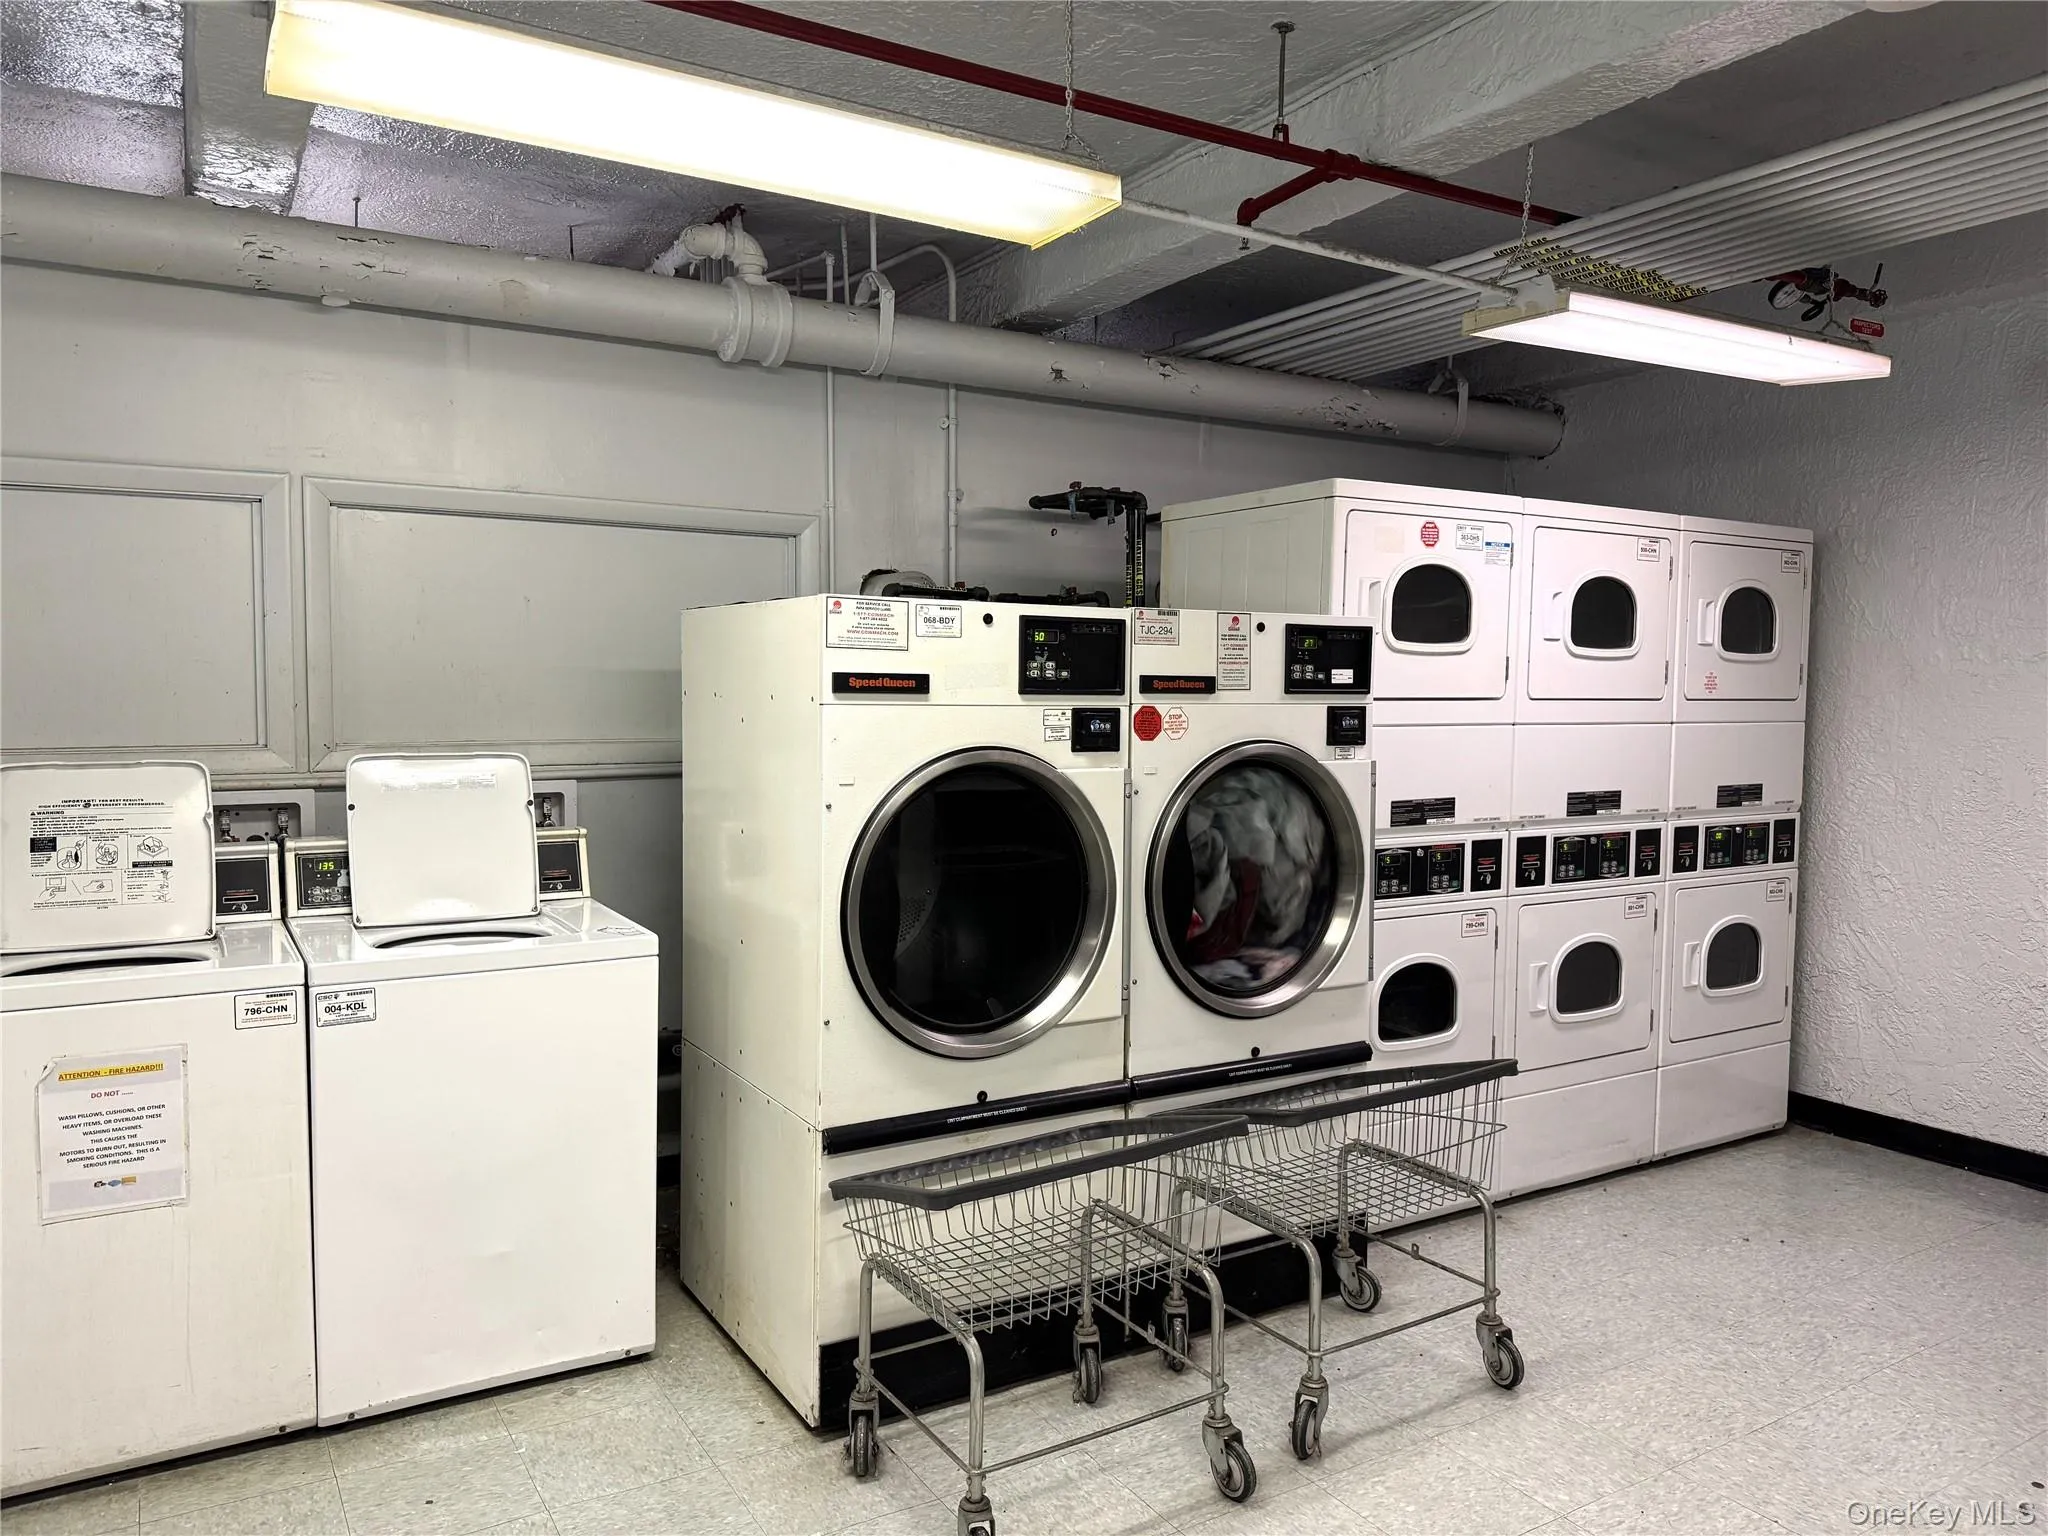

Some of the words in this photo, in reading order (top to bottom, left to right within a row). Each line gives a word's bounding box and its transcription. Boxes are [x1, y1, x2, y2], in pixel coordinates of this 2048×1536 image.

[1531, 237, 1548, 246] GAS
[1545, 245, 1560, 254] GAS
[1521, 254, 1556, 270] NATRAL
[1557, 250, 1575, 258] GAS
[1574, 255, 1592, 263] GAS
[1592, 261, 1610, 269] GAS
[1604, 264, 1623, 272] GAS
[1620, 268, 1638, 277] GAS
[1641, 270, 1660, 279] GAS
[1647, 275, 1664, 284] GAS
[1657, 280, 1675, 289] GAS
[1675, 285, 1693, 293] GAS
[1690, 287, 1708, 295] GAS
[924, 616, 955, 624] 068-BDY
[1140, 625, 1173, 635] TJC-294
[849, 677, 882, 688] Speed
[884, 677, 915, 687] Queen
[244, 1005, 287, 1016] 796-CHN
[324, 1002, 367, 1013] 004-KDL
[58, 1070, 101, 1080] ATTENTION
[126, 1064, 163, 1073] HAZARD!!!
[114, 1115, 144, 1123] OVERLOAD
[60, 1149, 85, 1157] MOTORS
[96, 1151, 133, 1160] CONDITIONS.
